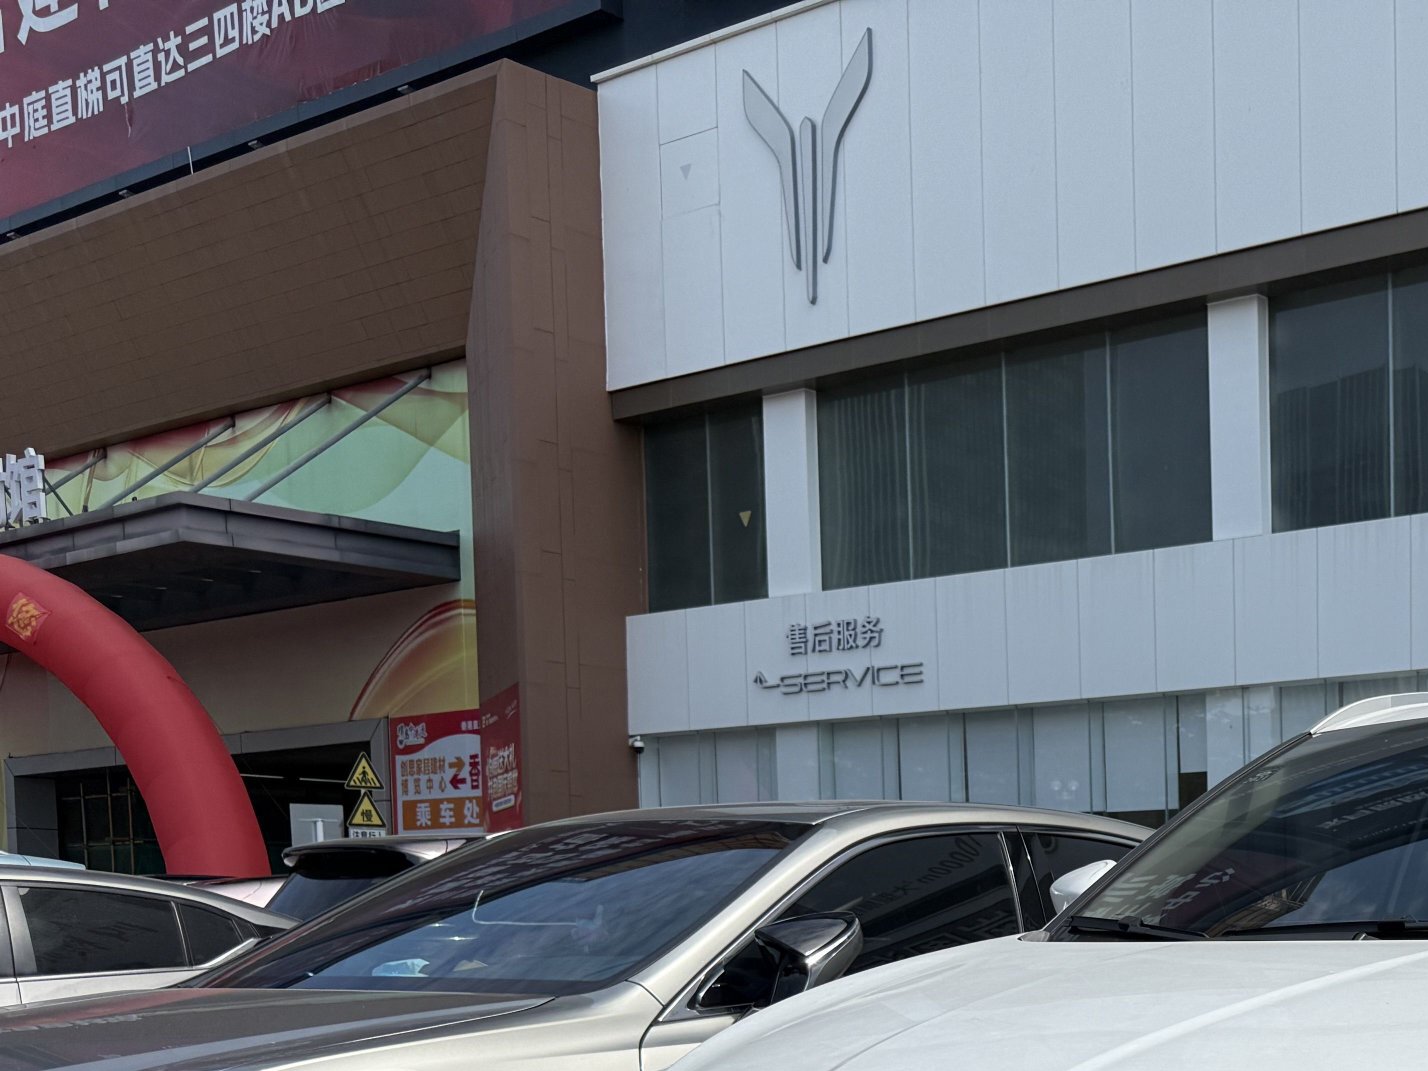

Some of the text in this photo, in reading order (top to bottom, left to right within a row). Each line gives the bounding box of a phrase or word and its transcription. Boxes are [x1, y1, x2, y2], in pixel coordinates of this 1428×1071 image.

[786, 615, 884, 657] 售后服务
[780, 661, 925, 696] SERVICE
[360, 808, 373, 823] 慢
[416, 799, 480, 828] 乘车处
